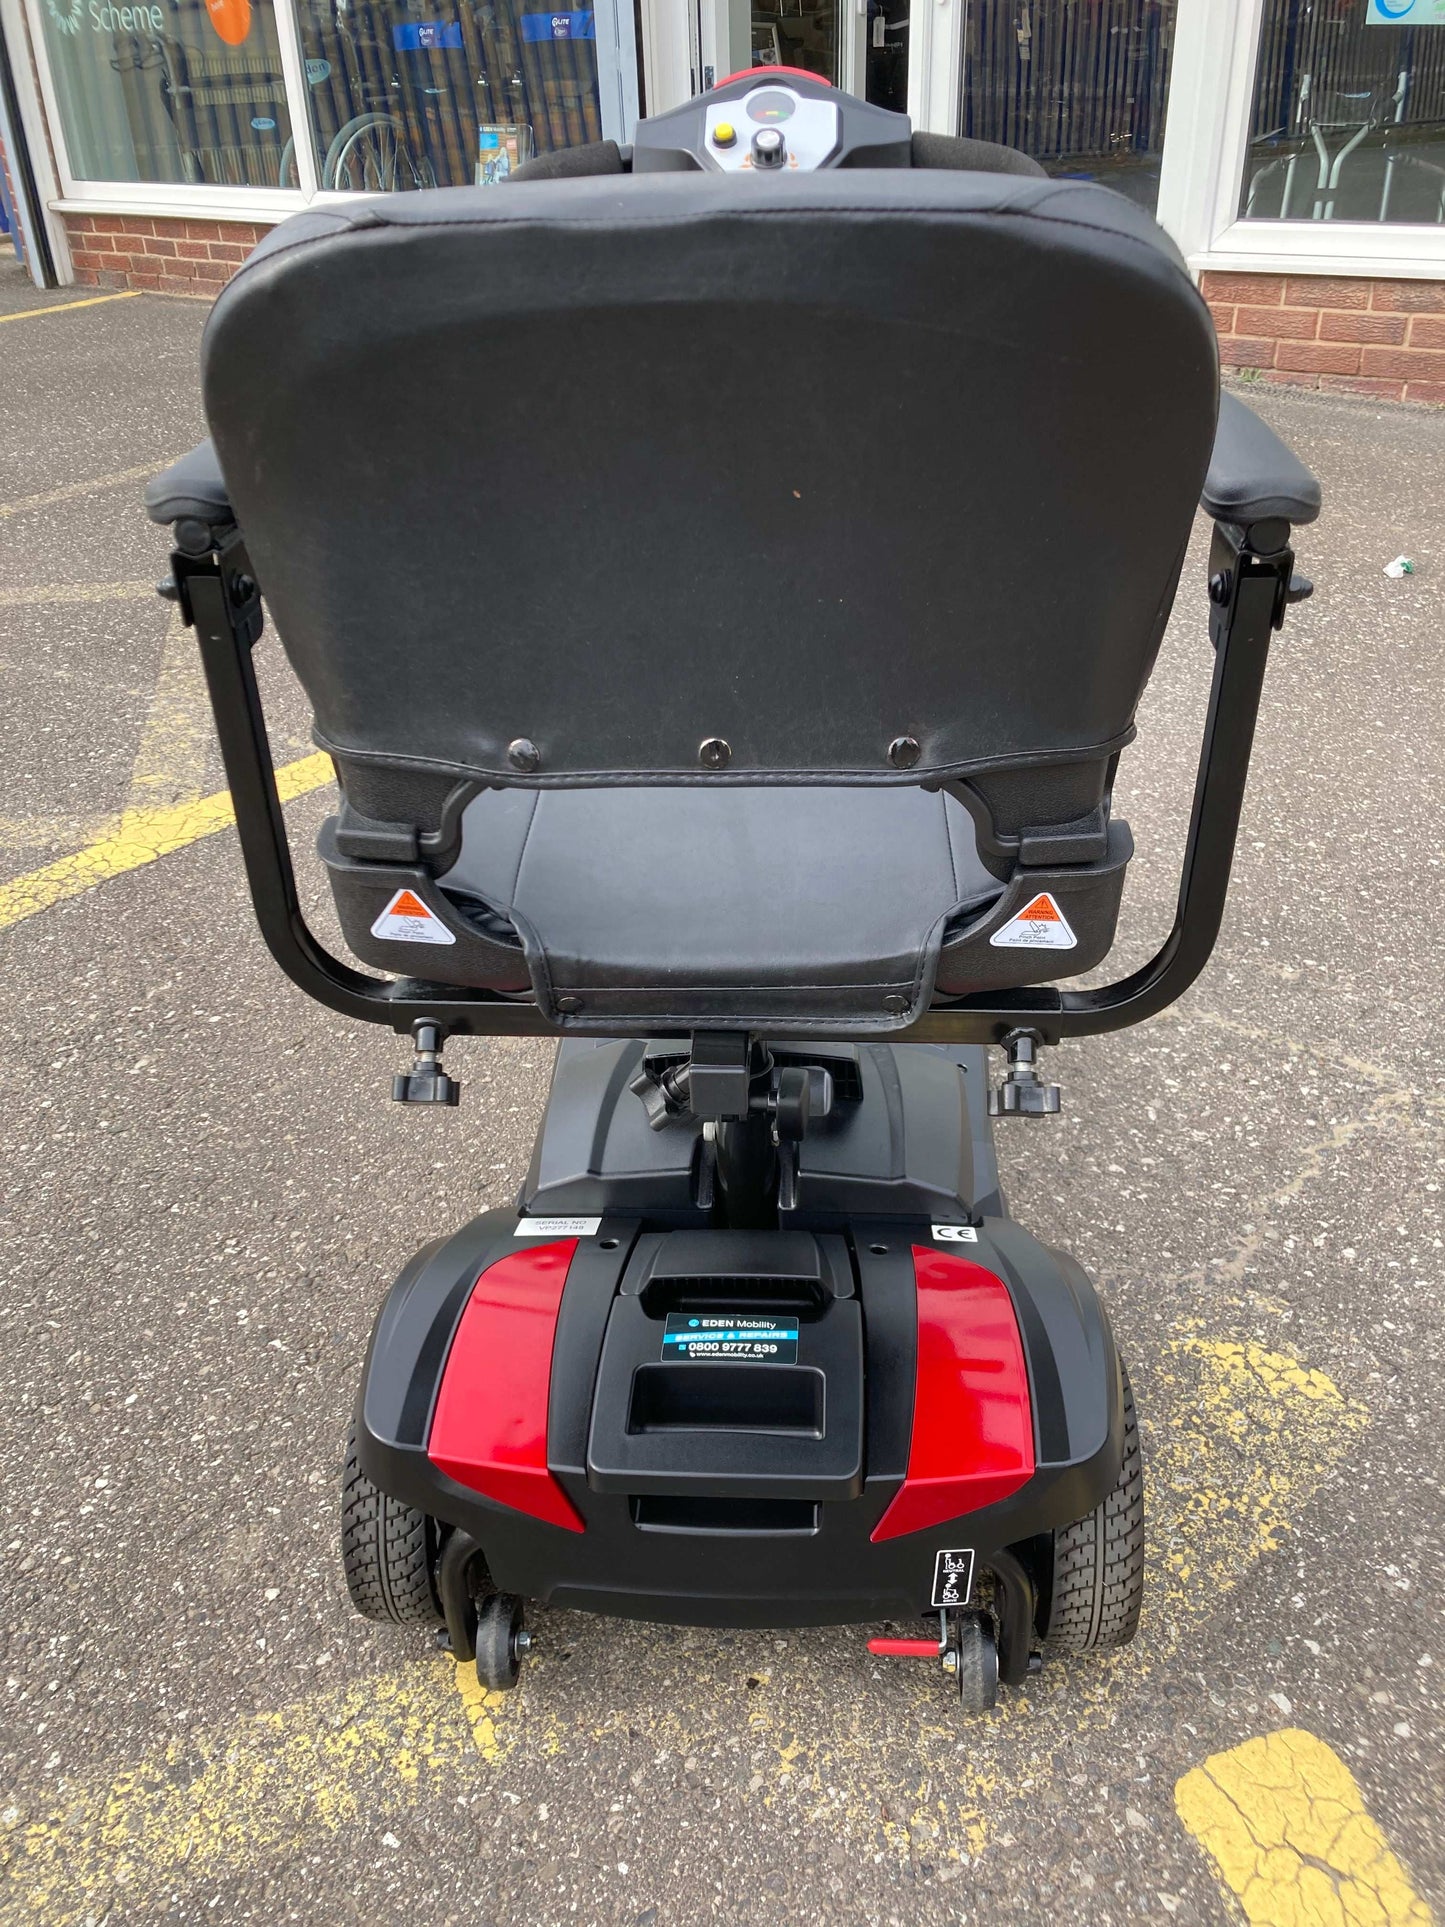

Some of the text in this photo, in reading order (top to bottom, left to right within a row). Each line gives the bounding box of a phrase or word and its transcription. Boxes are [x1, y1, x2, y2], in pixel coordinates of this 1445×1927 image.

[88, 1, 164, 32] Scheme
[937, 1227, 973, 1240] CE
[702, 1319, 776, 1329] EDEN Mobility
[675, 1332, 725, 1342] SERVICE
[739, 1331, 789, 1339] REPAIRS
[688, 1342, 778, 1353] 0800 9777 839
